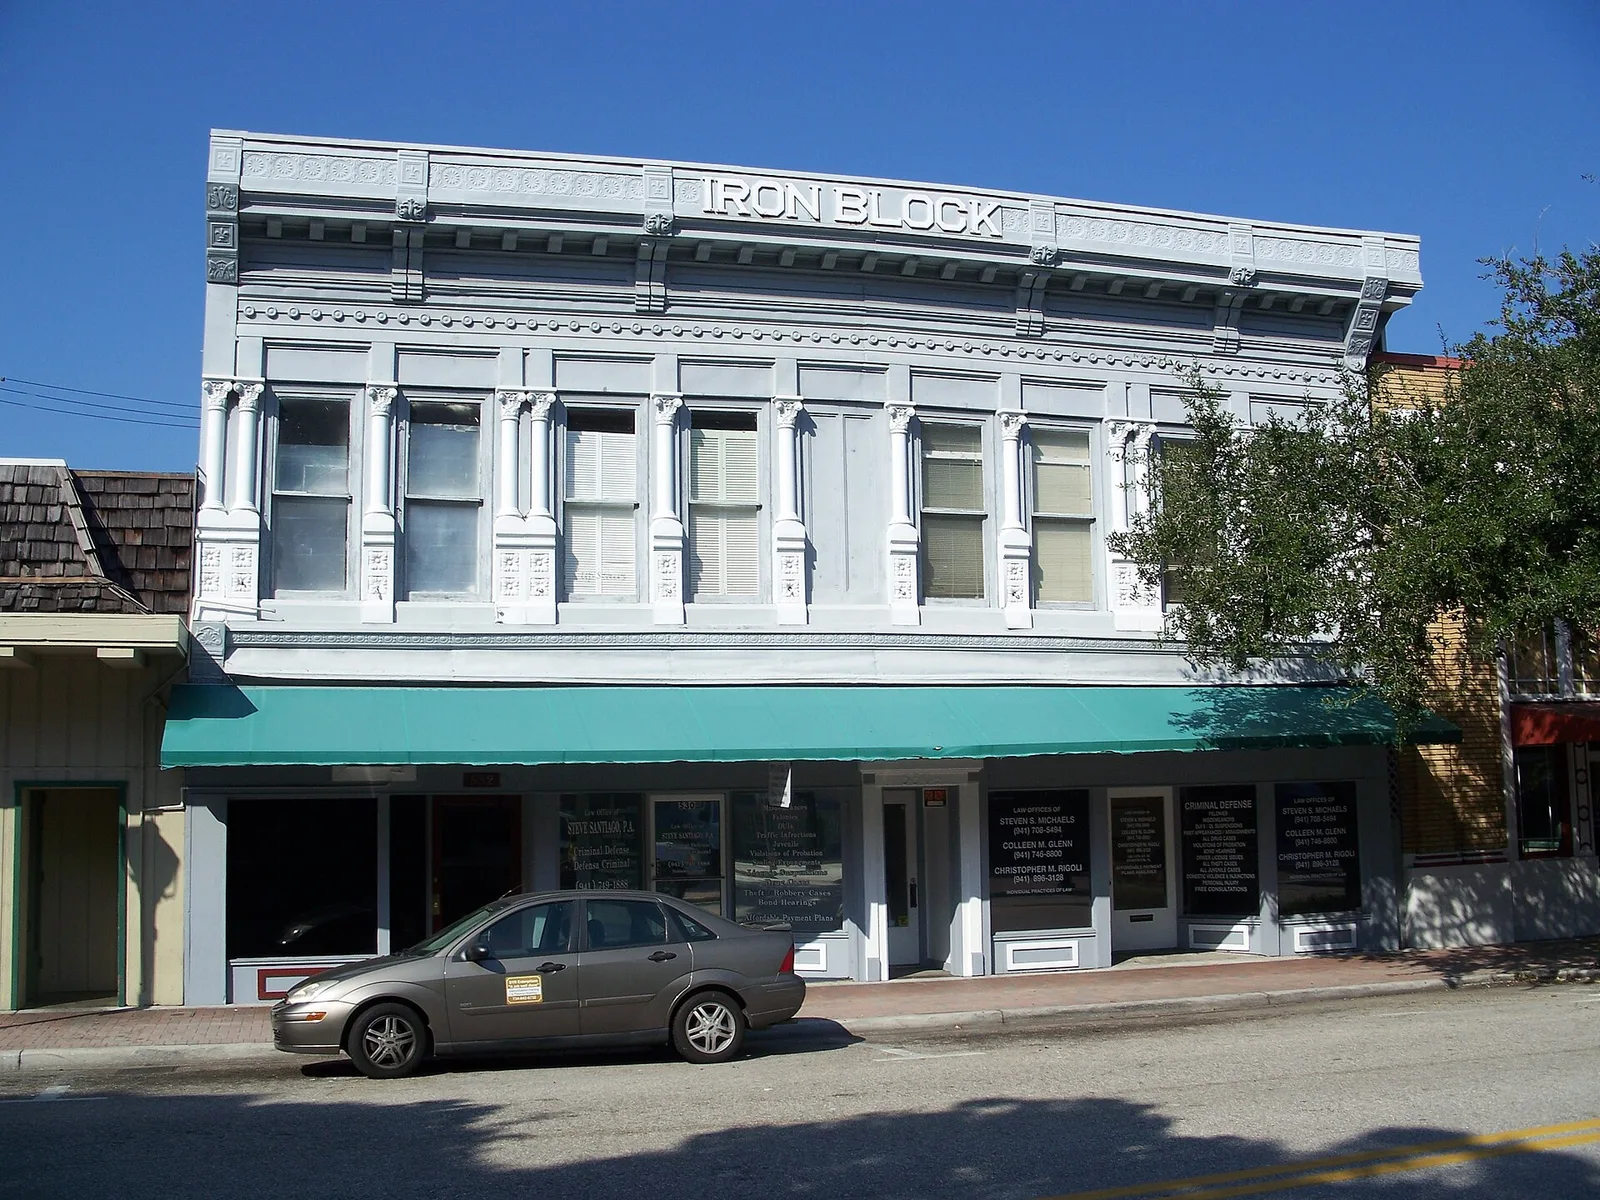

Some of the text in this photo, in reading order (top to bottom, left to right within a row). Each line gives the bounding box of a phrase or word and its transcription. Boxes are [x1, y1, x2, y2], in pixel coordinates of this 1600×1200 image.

[701, 177, 1003, 238] IRON BLOCK
[679, 802, 695, 810] 530
[1184, 800, 1252, 810] CRIMINAL DEFENSE
[1316, 806, 1347, 814] MICHAELS
[1000, 818, 1028, 826] STEVEN
[1038, 816, 1075, 824] MICHAELS
[568, 821, 636, 834] STEVE SANTIAGO, P.A.
[1014, 827, 1030, 836] (941)
[1285, 829, 1315, 837] COLLEEN
[1002, 841, 1036, 849] COLLEEN
[1296, 838, 1310, 846] (941)
[574, 845, 630, 856] Criminal Defense
[1014, 851, 1030, 860] (941)
[1279, 852, 1324, 860] CHRISTOPHER
[602, 858, 630, 868] Criminal
[1296, 861, 1310, 870] (941)
[994, 866, 1046, 874] CHRISTOPHER
[1014, 874, 1064, 884] (941) 896-3128
[576, 880, 628, 890] (941) 749-1888
[774, 890, 804, 898] Robbery
[781, 899, 816, 907] Hearings
